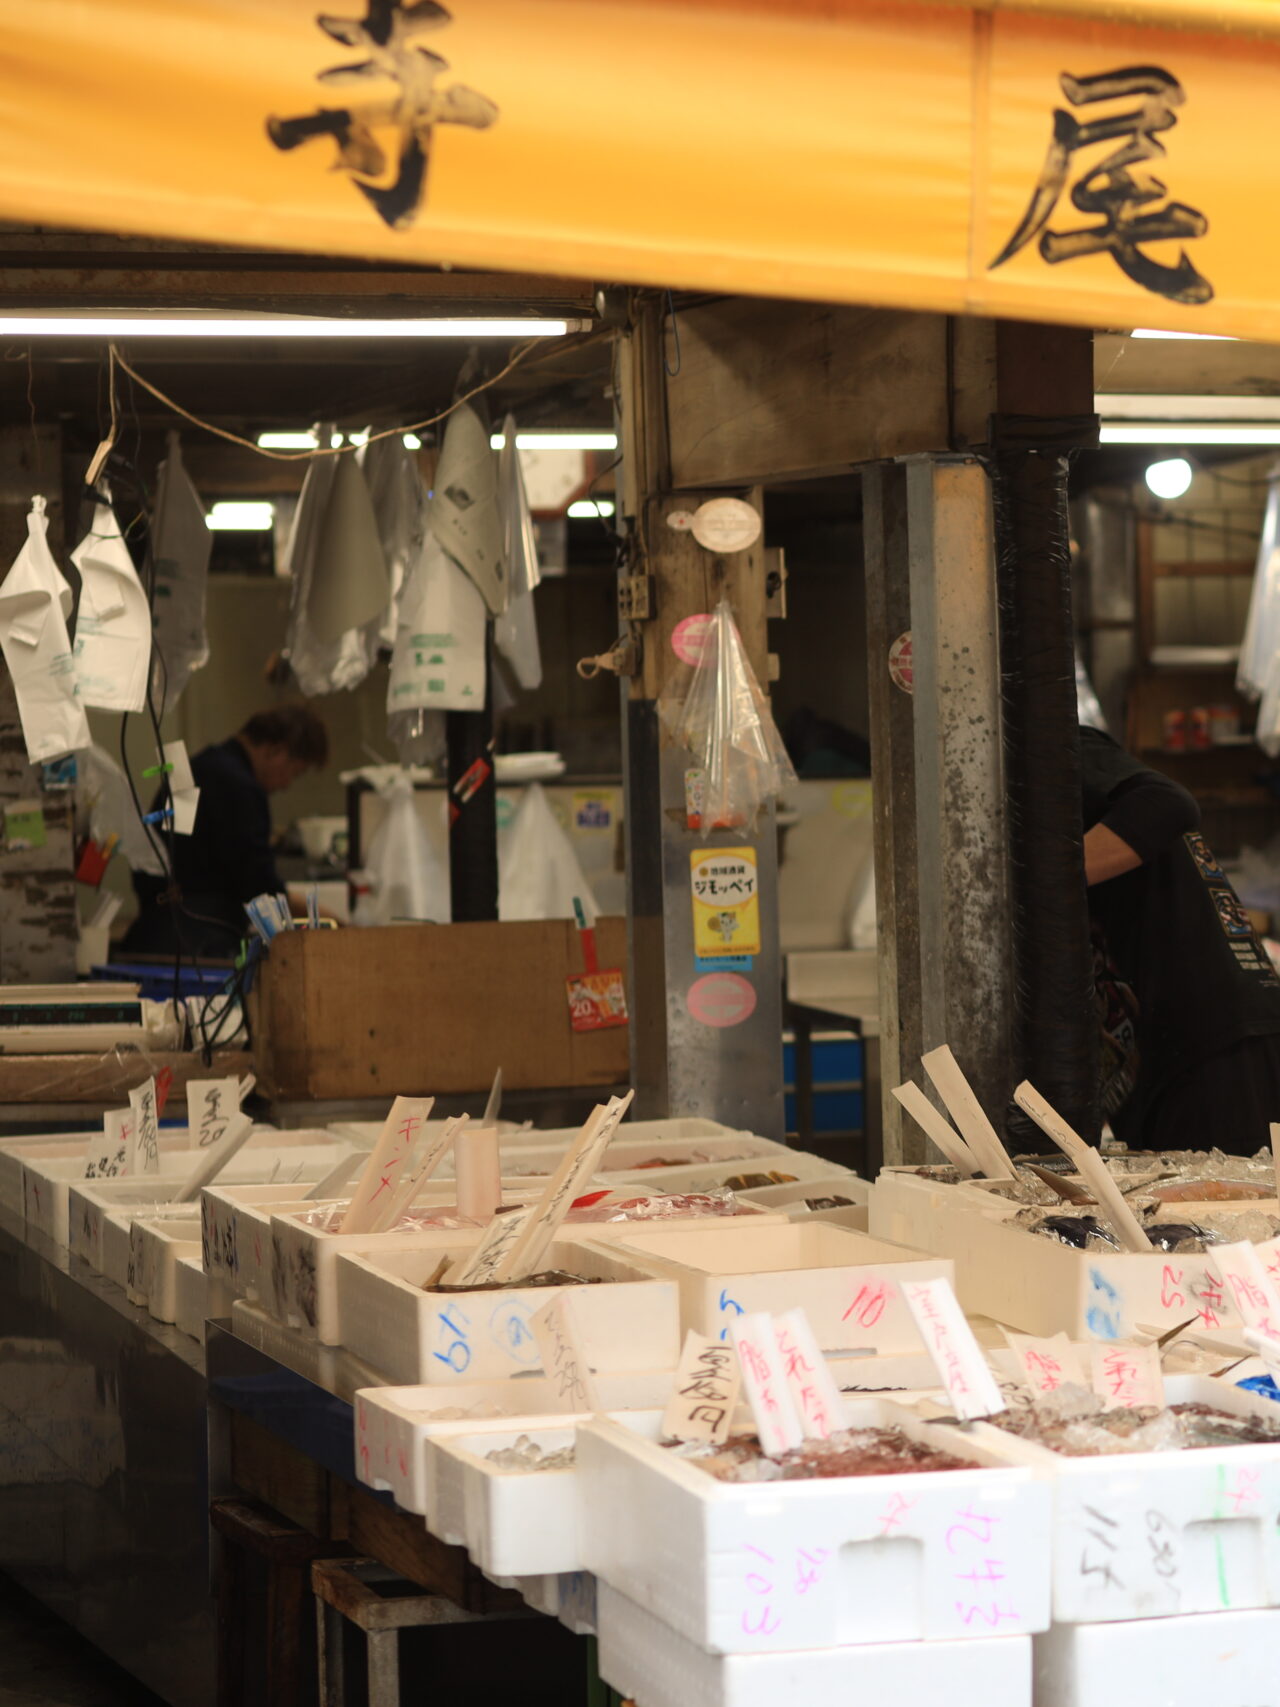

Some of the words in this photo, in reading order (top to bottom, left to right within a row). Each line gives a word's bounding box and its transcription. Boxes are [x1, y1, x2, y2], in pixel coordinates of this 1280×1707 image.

[694, 878, 754, 895] ジモッペイ
